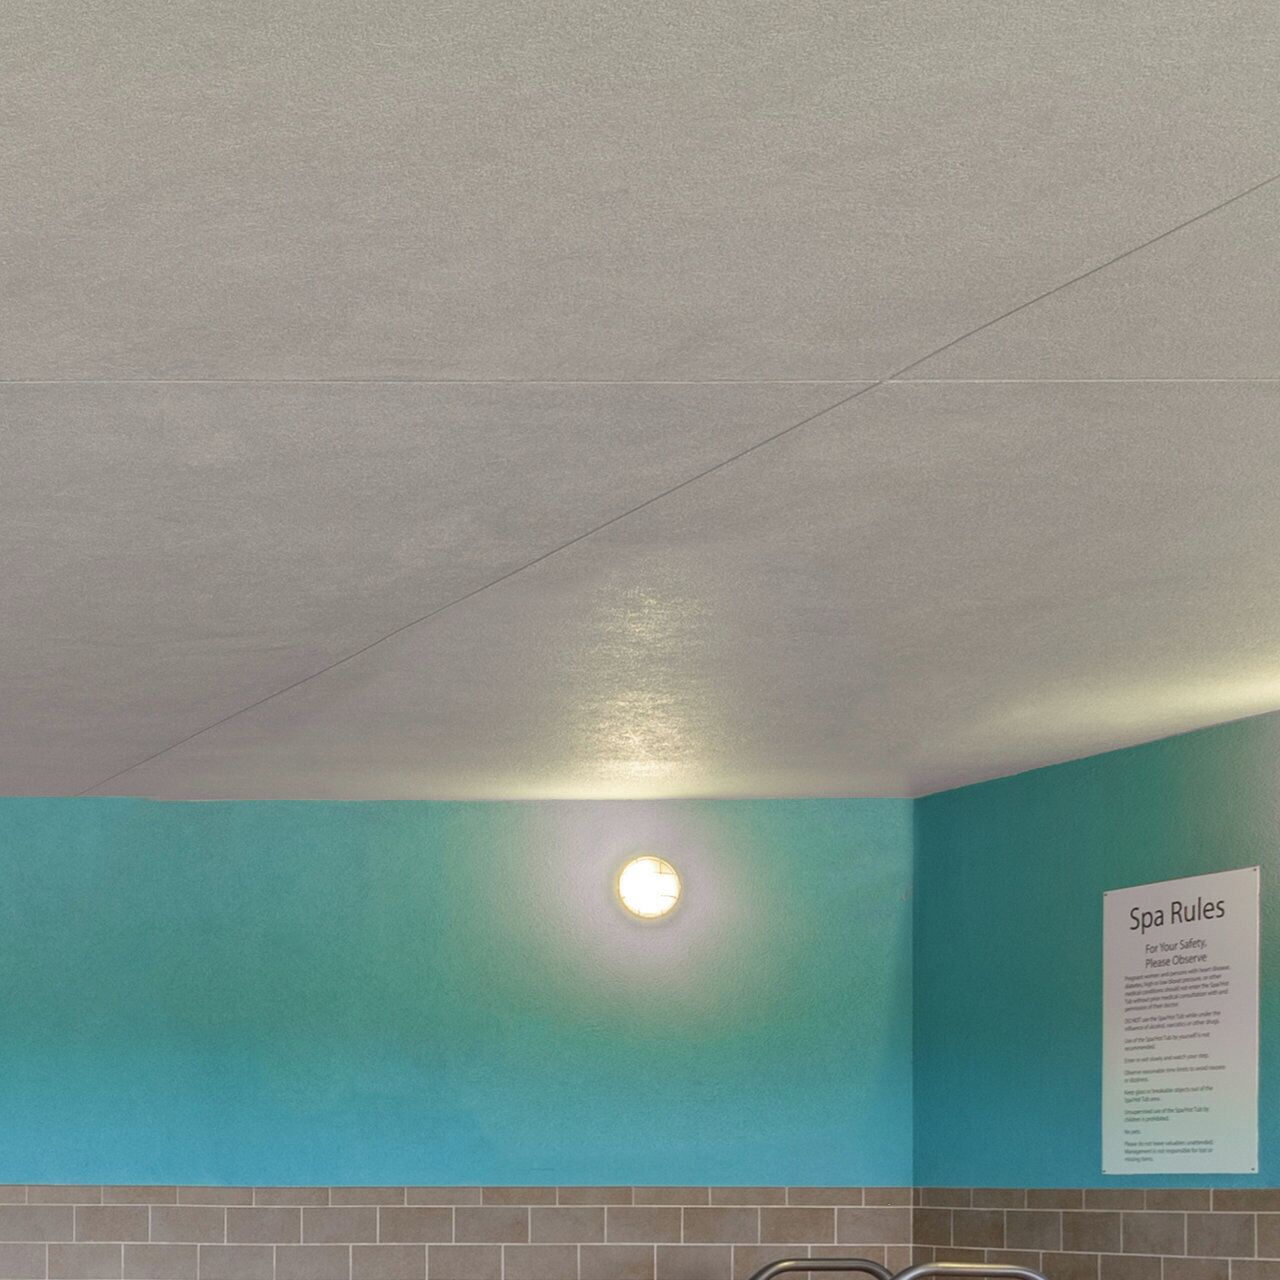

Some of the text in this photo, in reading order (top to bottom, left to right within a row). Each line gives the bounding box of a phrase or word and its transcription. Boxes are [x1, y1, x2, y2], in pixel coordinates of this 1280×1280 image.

[1129, 896, 1225, 935] Spa Rules
[1145, 944, 1158, 954] For
[1159, 942, 1178, 953] Your
[1145, 954, 1207, 969] Please Observe
